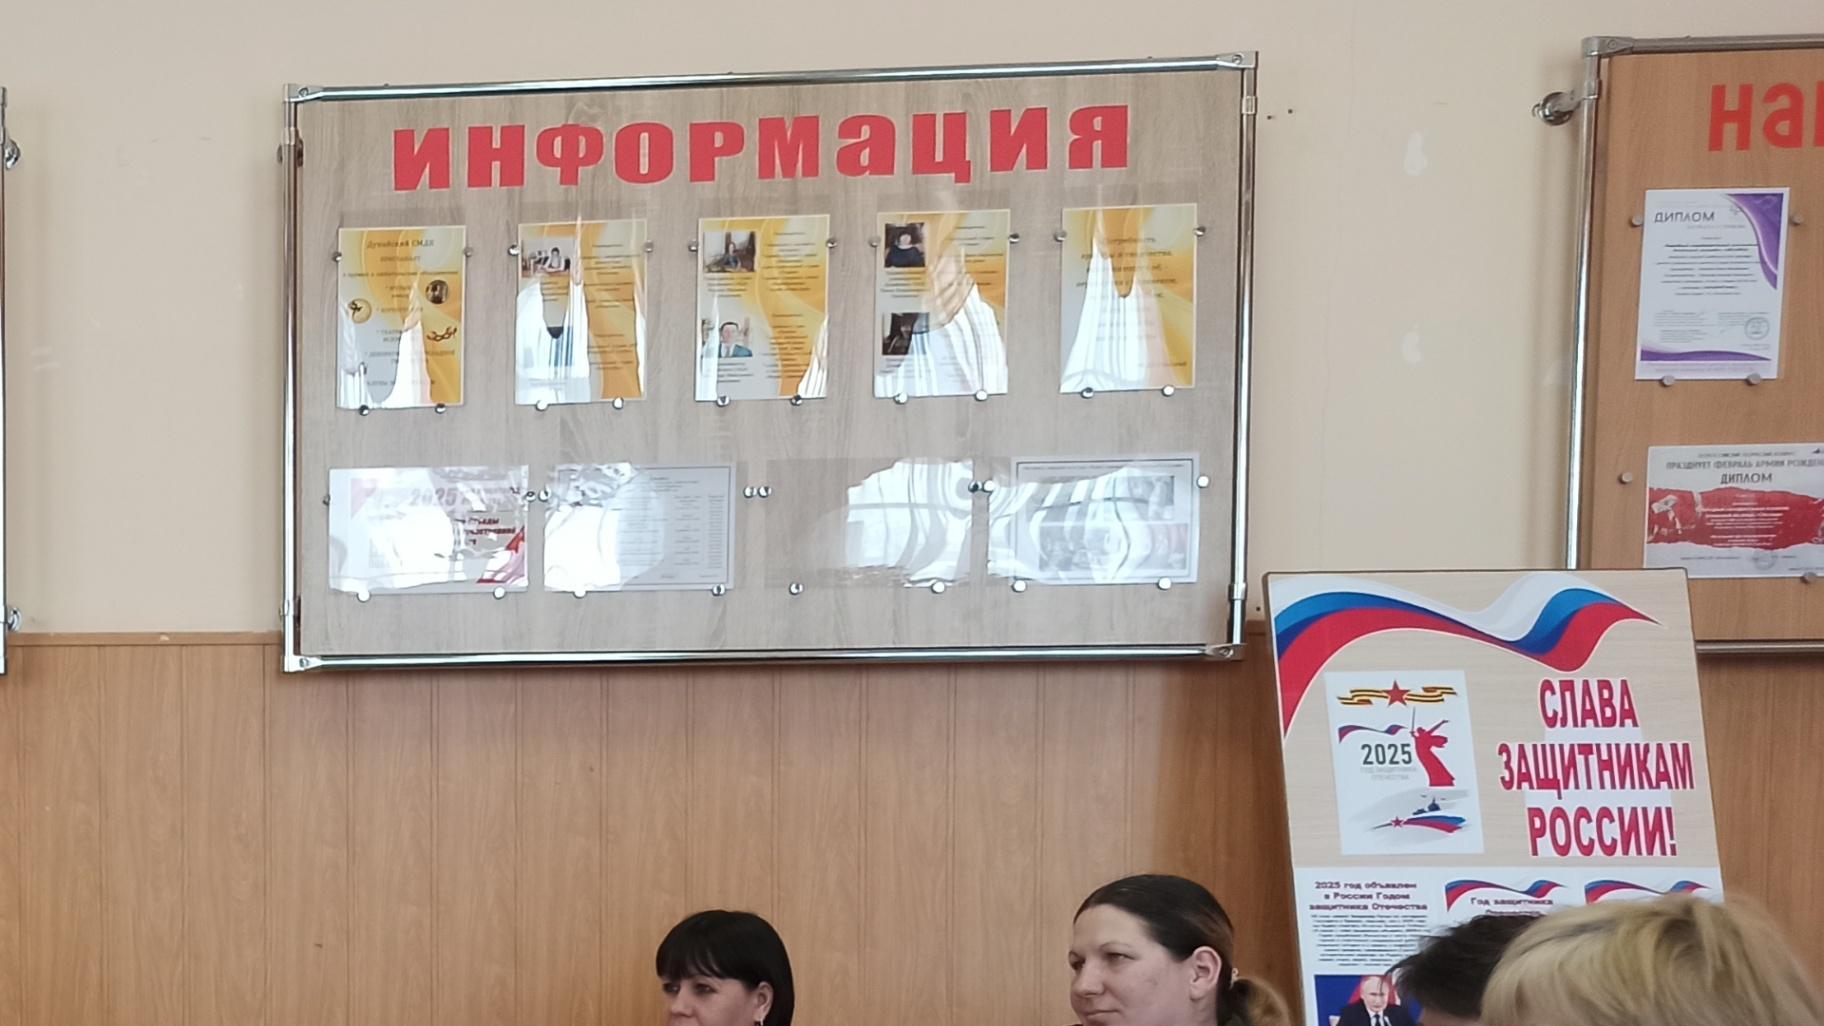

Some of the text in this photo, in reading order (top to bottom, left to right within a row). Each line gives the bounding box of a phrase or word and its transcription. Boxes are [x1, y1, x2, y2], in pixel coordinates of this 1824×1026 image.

[1654, 211, 1716, 223] ДИПЛОМ
[1720, 473, 1773, 485] ДИПЛОМ
[1539, 679, 1639, 728] СЛАВА
[1361, 743, 1412, 765] 2025
[1497, 743, 1695, 800] ЗАЩИТНИКАМ
[1527, 806, 1677, 857] РОССИИ!
[1315, 881, 1417, 890] 2025 год объявлен
[1333, 892, 1373, 900] России
[1376, 892, 1411, 900] Годом
[1471, 897, 1490, 905] Год
[1309, 903, 1428, 911] защитника Отечества
